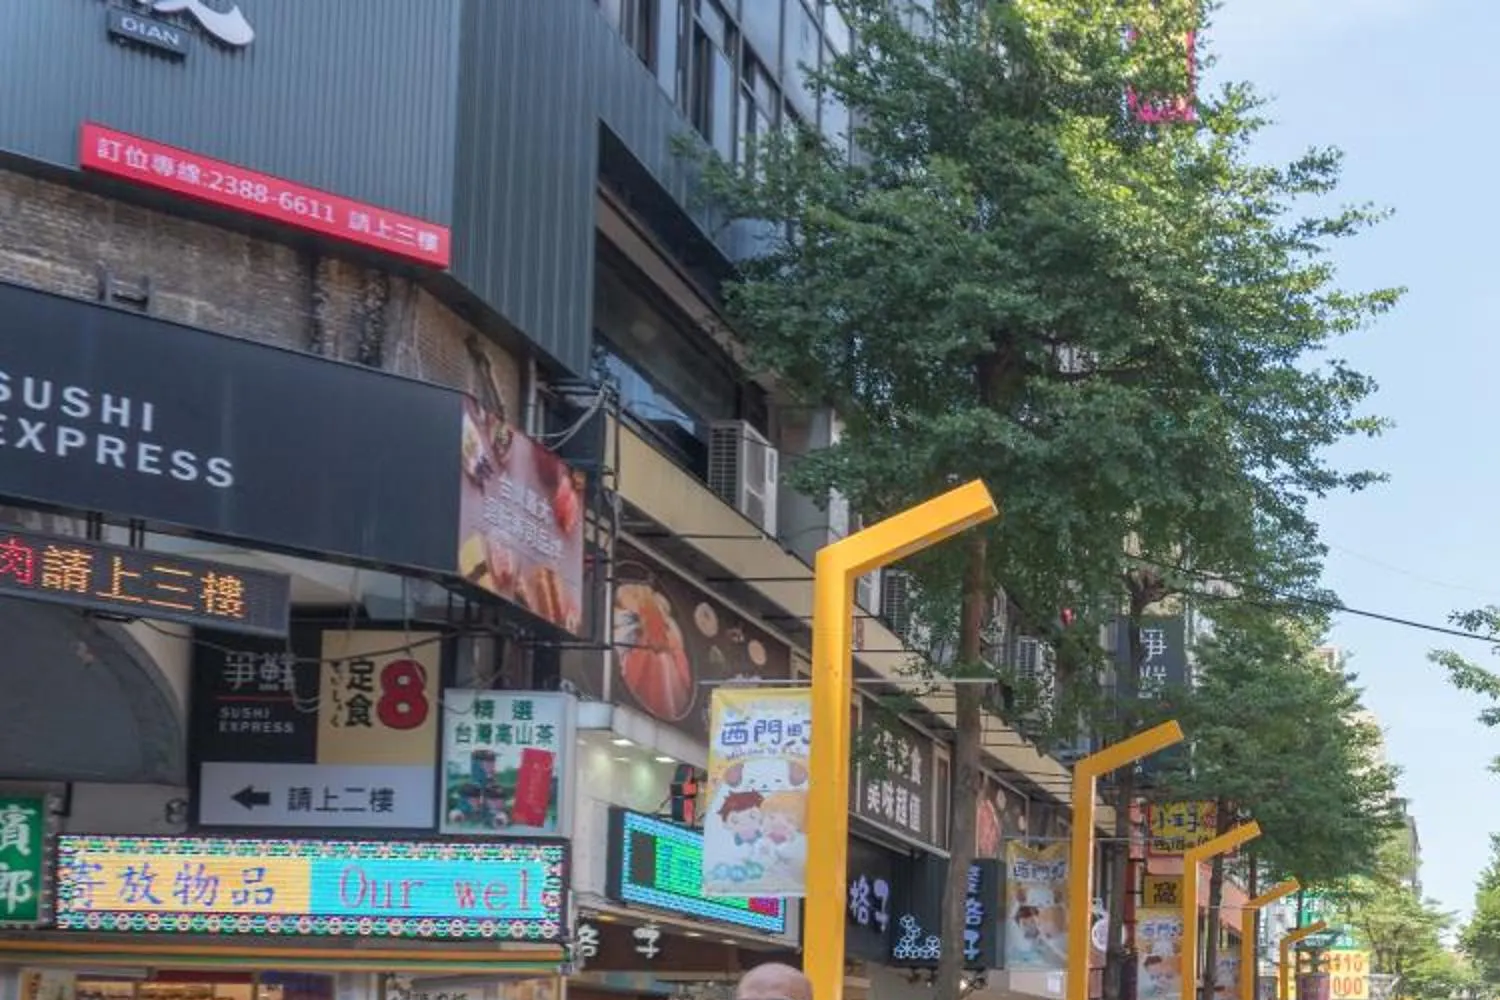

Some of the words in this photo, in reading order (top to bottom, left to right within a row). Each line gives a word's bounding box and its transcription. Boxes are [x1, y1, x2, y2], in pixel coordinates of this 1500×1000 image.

[121, 16, 180, 45] DIAN
[344, 655, 377, 728] 定食
[375, 658, 430, 731] 8
[218, 706, 271, 720] SUSHI
[218, 721, 295, 734] EXPRESS
[287, 786, 395, 814] 請上二樓
[339, 863, 425, 910] Our
